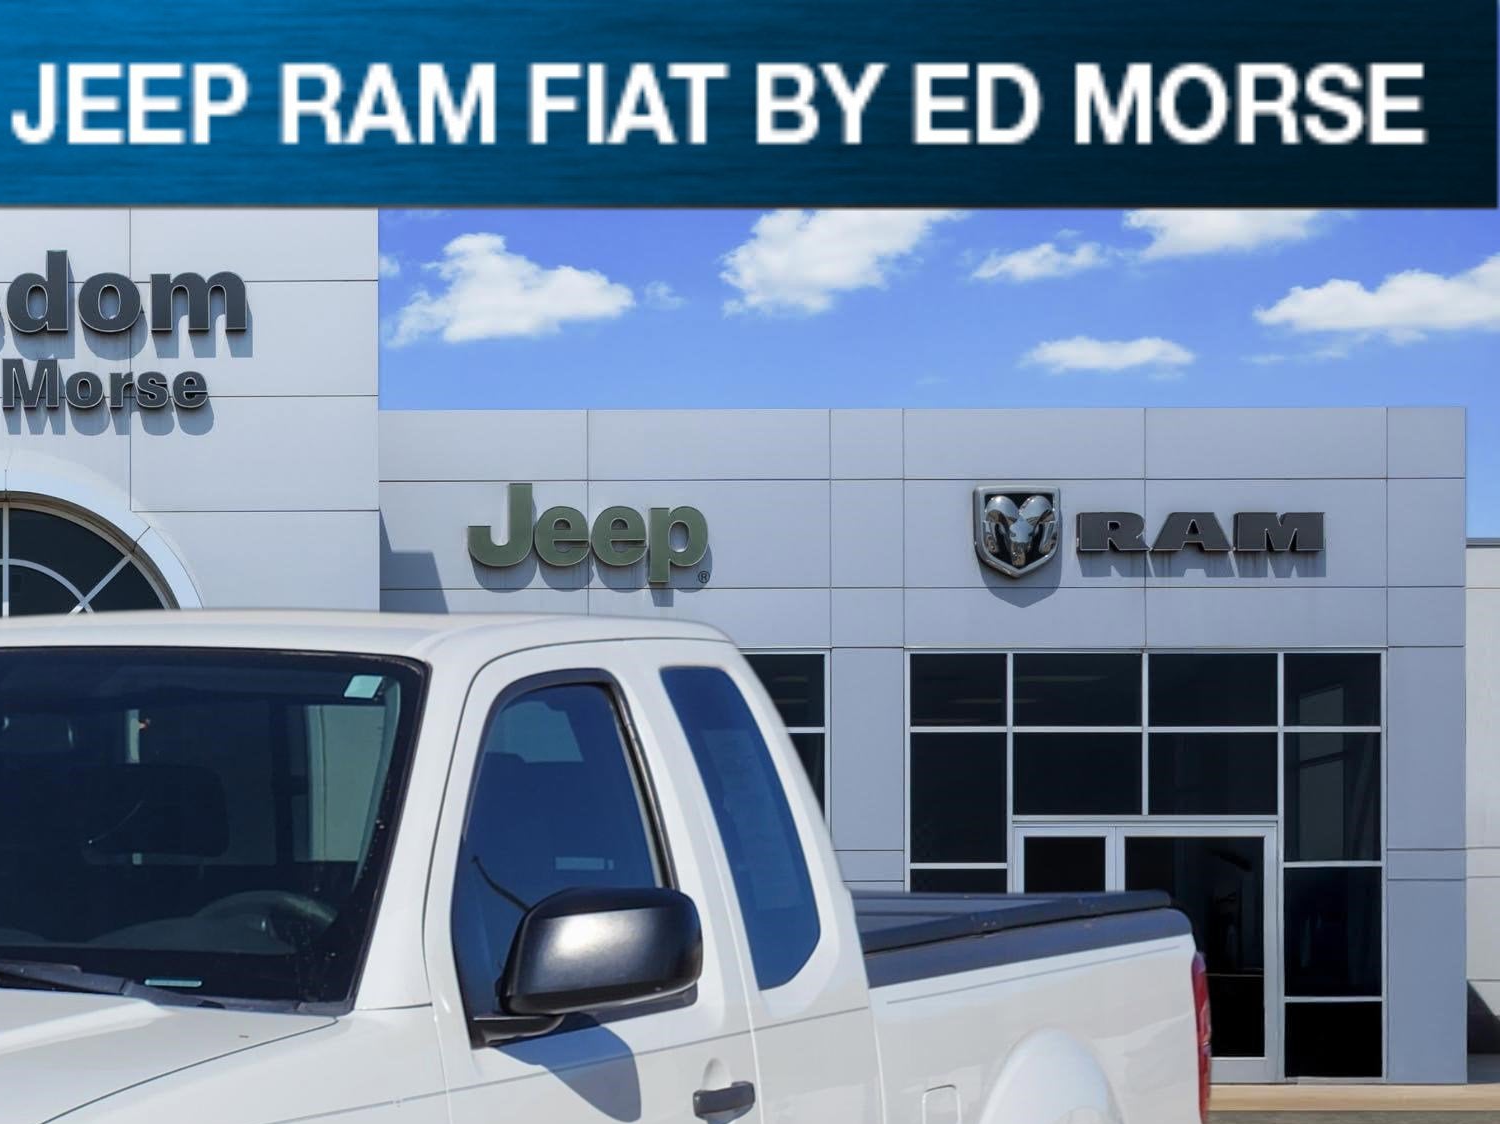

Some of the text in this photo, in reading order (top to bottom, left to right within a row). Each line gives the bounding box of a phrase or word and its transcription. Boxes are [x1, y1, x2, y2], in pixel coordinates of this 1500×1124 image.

[2, 358, 209, 409] Morse
[467, 483, 708, 584] Jeep
[1076, 511, 1326, 552] RAM
